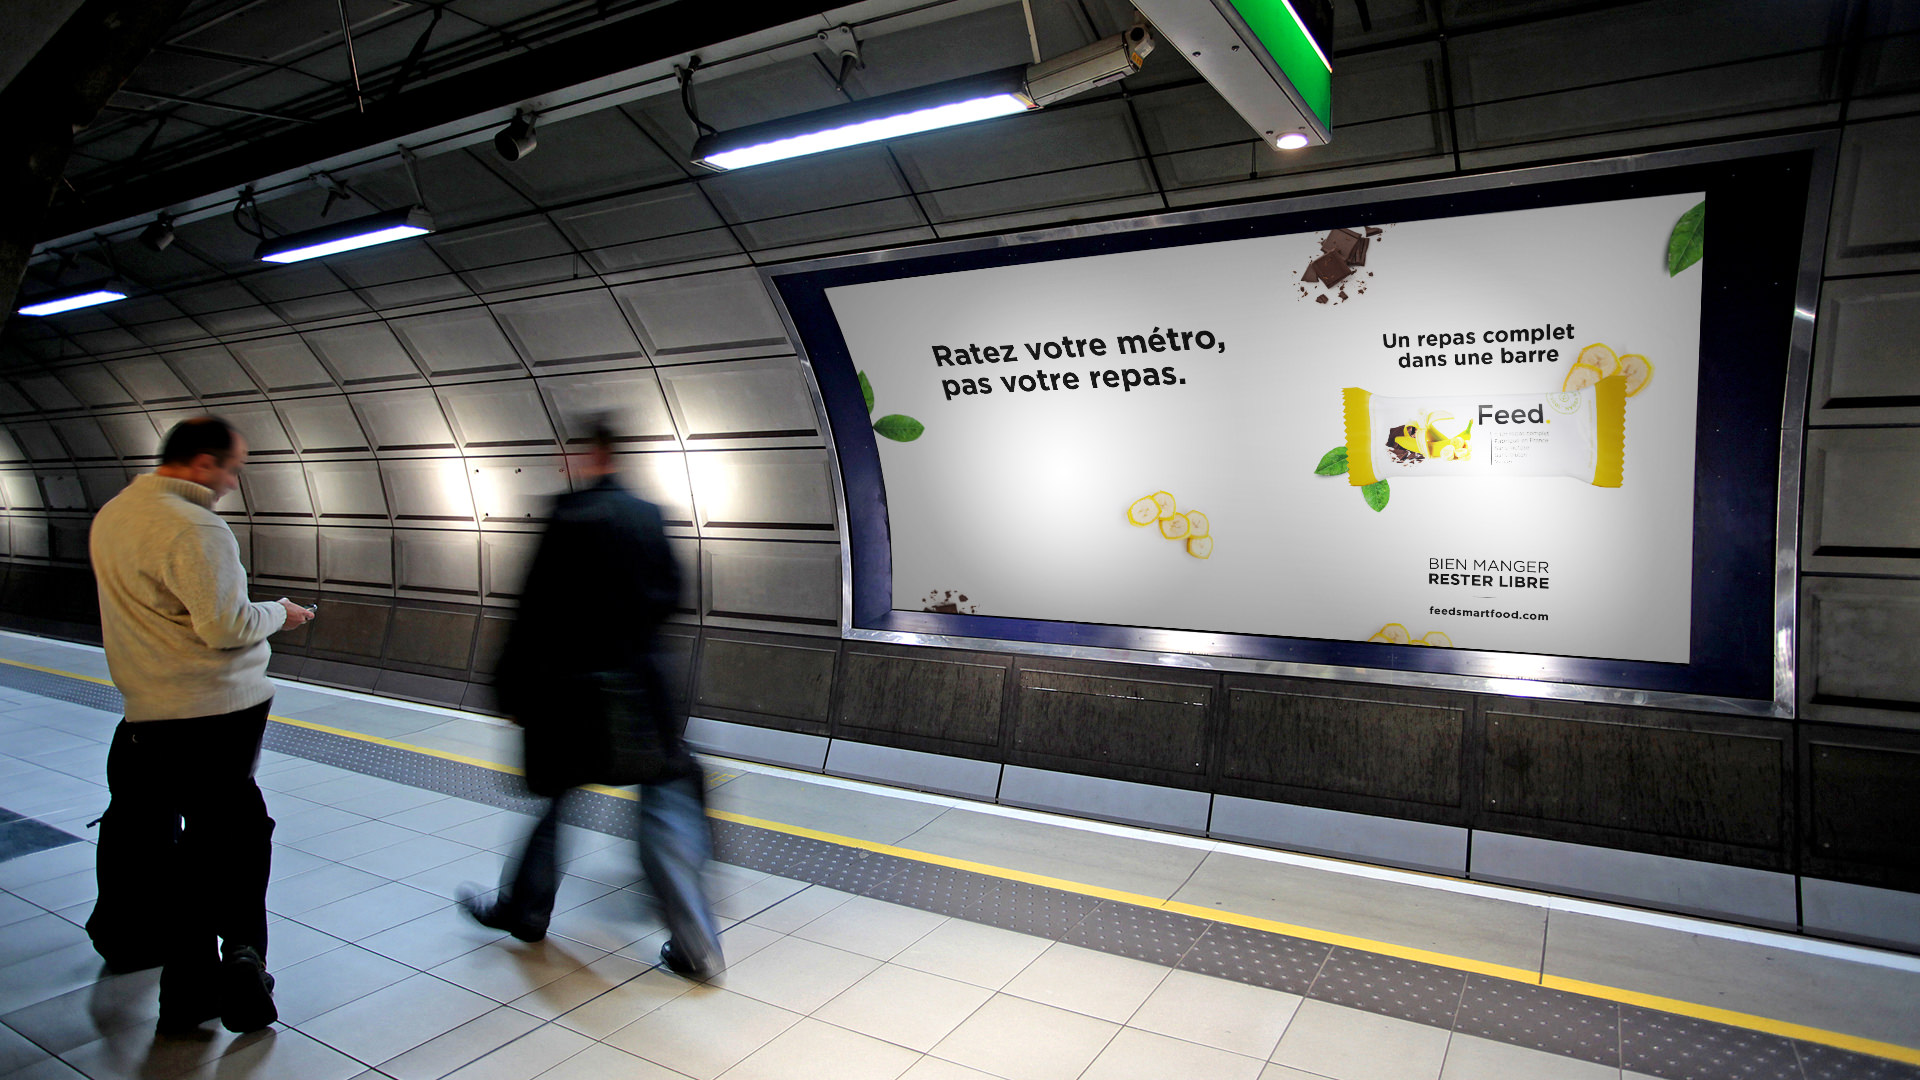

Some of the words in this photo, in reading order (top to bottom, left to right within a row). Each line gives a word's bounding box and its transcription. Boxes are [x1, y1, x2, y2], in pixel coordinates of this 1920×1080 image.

[931, 344, 1018, 367] Ratez
[1023, 336, 1107, 361] votre
[1116, 326, 1226, 355] métro,
[1382, 333, 1410, 349] Un
[1417, 331, 1476, 349] repas
[1482, 323, 1575, 345] complet
[1398, 352, 1447, 369] dans
[1454, 352, 1494, 366] une
[1500, 347, 1560, 364] barre
[941, 376, 993, 401] pas
[999, 370, 1080, 393] votre
[1089, 366, 1186, 392] repas.
[1429, 557, 1467, 571] BIEN
[1473, 559, 1549, 574] MANGER
[1428, 573, 1494, 587] RESTER
[1499, 575, 1550, 590] LIBRE
[1429, 605, 1549, 621] feedsmartfood.com
